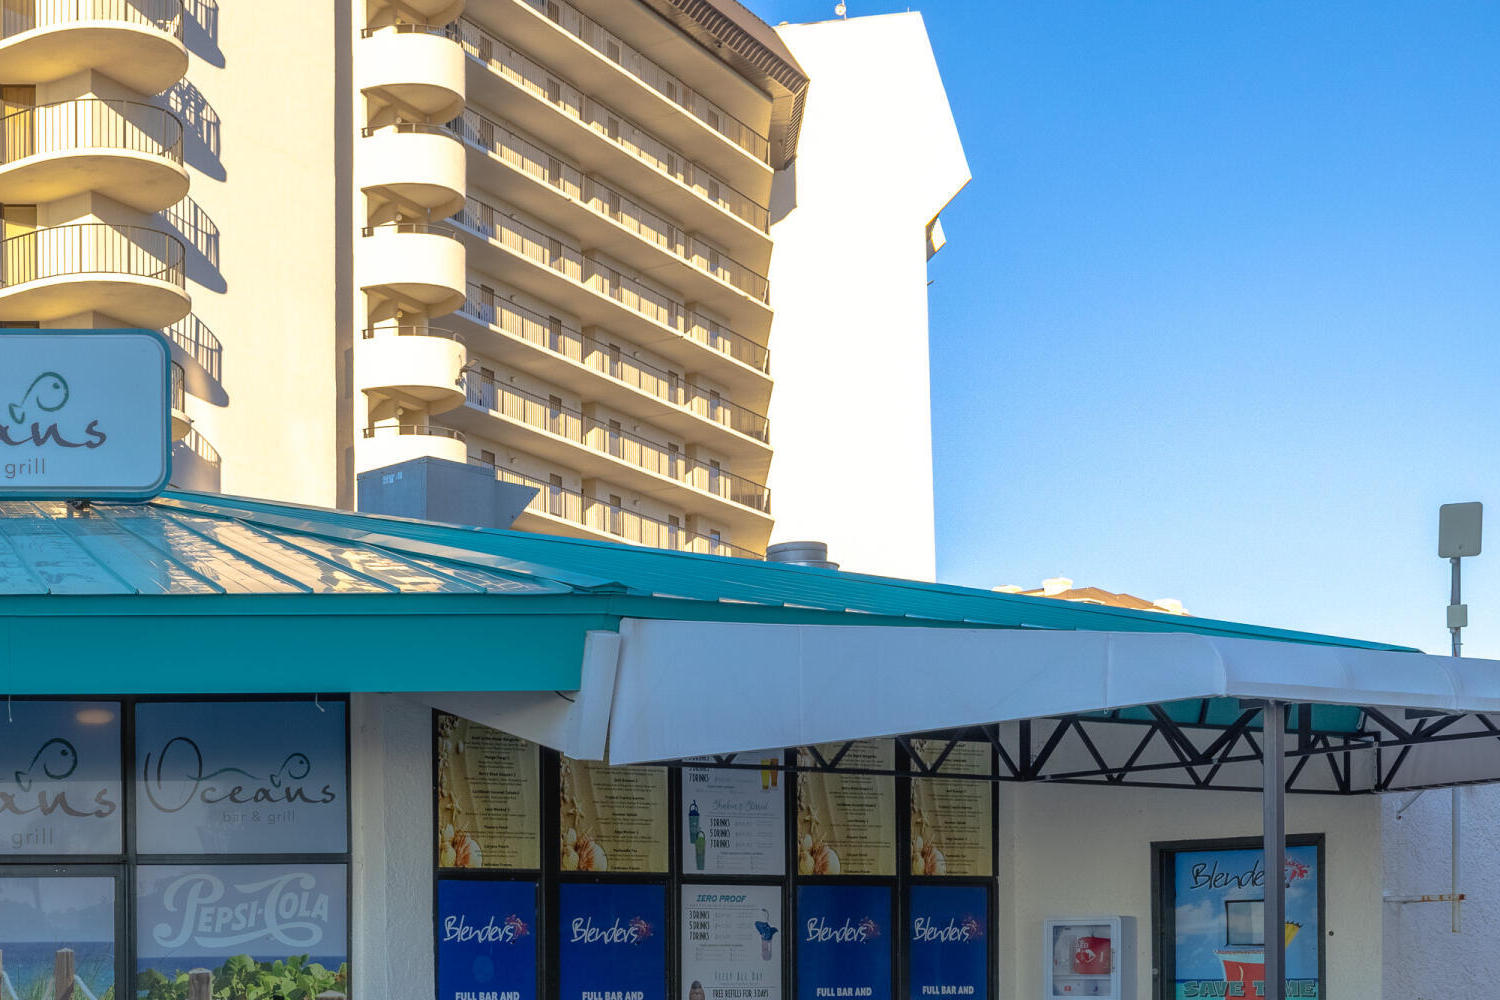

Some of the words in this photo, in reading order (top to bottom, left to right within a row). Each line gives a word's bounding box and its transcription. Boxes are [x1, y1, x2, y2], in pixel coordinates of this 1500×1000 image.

[4, 458, 46, 479] grill
[144, 736, 336, 813] Oceans
[222, 811, 246, 823] bar
[251, 811, 261, 823] &
[268, 811, 296, 825] grill
[11, 828, 53, 849] grill
[1190, 859, 1288, 890] Blende
[696, 894, 718, 903] ZERO
[719, 895, 747, 903] PROOF
[443, 914, 514, 944] Blenders
[570, 916, 639, 944] Blenders
[806, 916, 868, 943] Blenders
[912, 916, 970, 943] Blenders
[478, 991, 498, 1000] BAR
[499, 991, 520, 1000] AND
[582, 991, 603, 1000] FULL
[604, 991, 624, 1000] BAR
[625, 991, 644, 1000] AND
[816, 987, 835, 997] FULL
[836, 987, 853, 997] BAR
[854, 987, 872, 996] AND
[922, 985, 940, 995] FULL
[941, 985, 957, 995] BAR
[958, 985, 974, 995] AND
[1183, 979, 1245, 998] SAVE
[1252, 979, 1316, 998] TME
